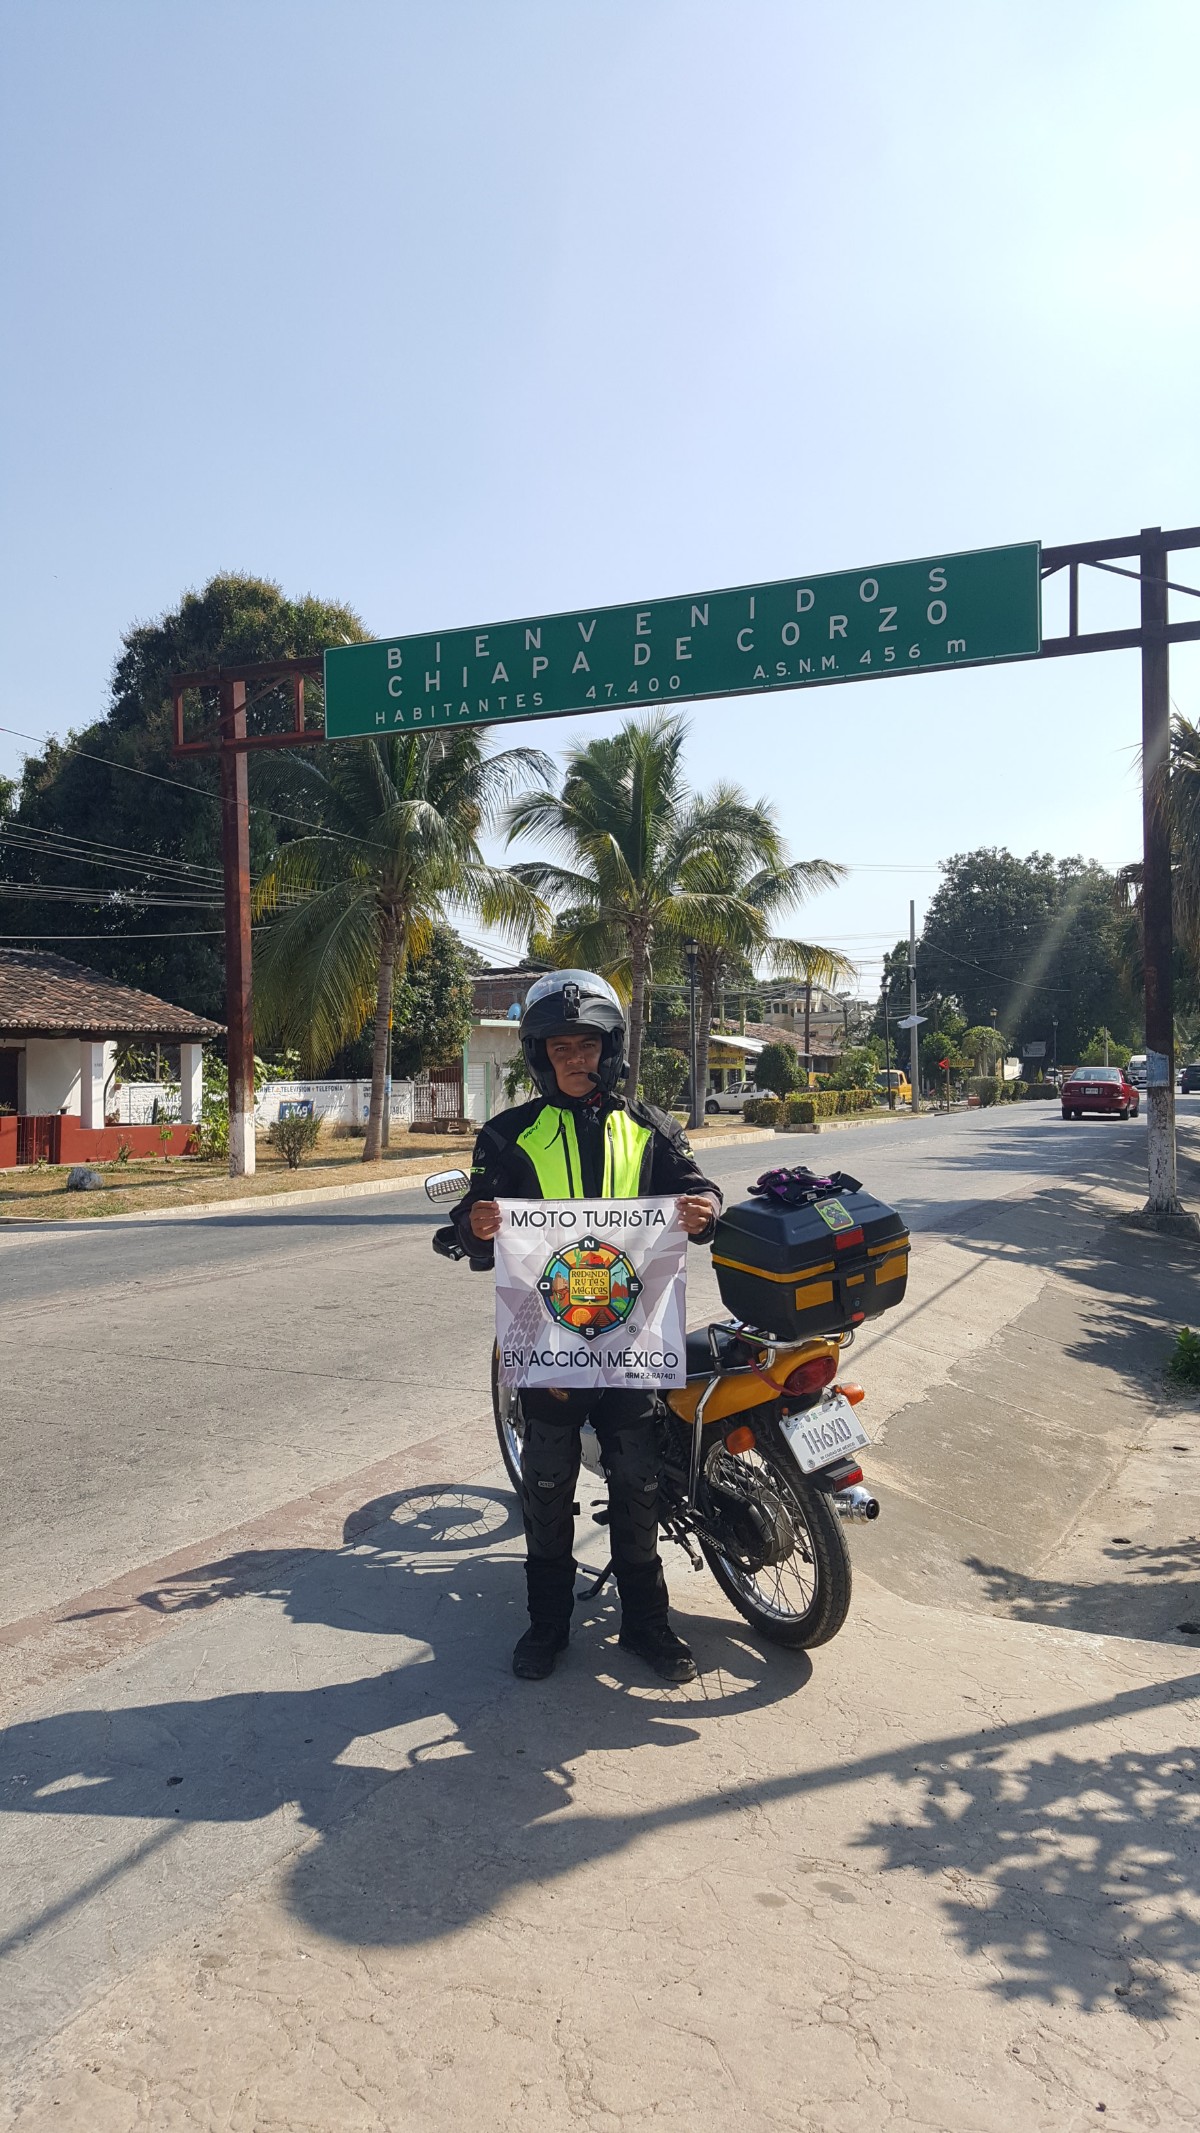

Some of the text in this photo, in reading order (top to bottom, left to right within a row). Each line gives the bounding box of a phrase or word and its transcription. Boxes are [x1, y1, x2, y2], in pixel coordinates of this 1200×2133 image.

[387, 567, 947, 669] BIENVENIDOS
[388, 600, 947, 697] CHIAPA DE CORZO
[375, 639, 966, 725] HABITANTES 47.400 A.S.N.M. 456 m
[510, 1209, 667, 1228] MOTO TURISTA
[584, 1240, 595, 1248] N
[630, 1283, 639, 1291] E
[585, 1327, 595, 1336] S
[504, 1347, 679, 1368] EN ACCIÓN MÉXICO
[801, 1417, 852, 1455] 1H6XD
